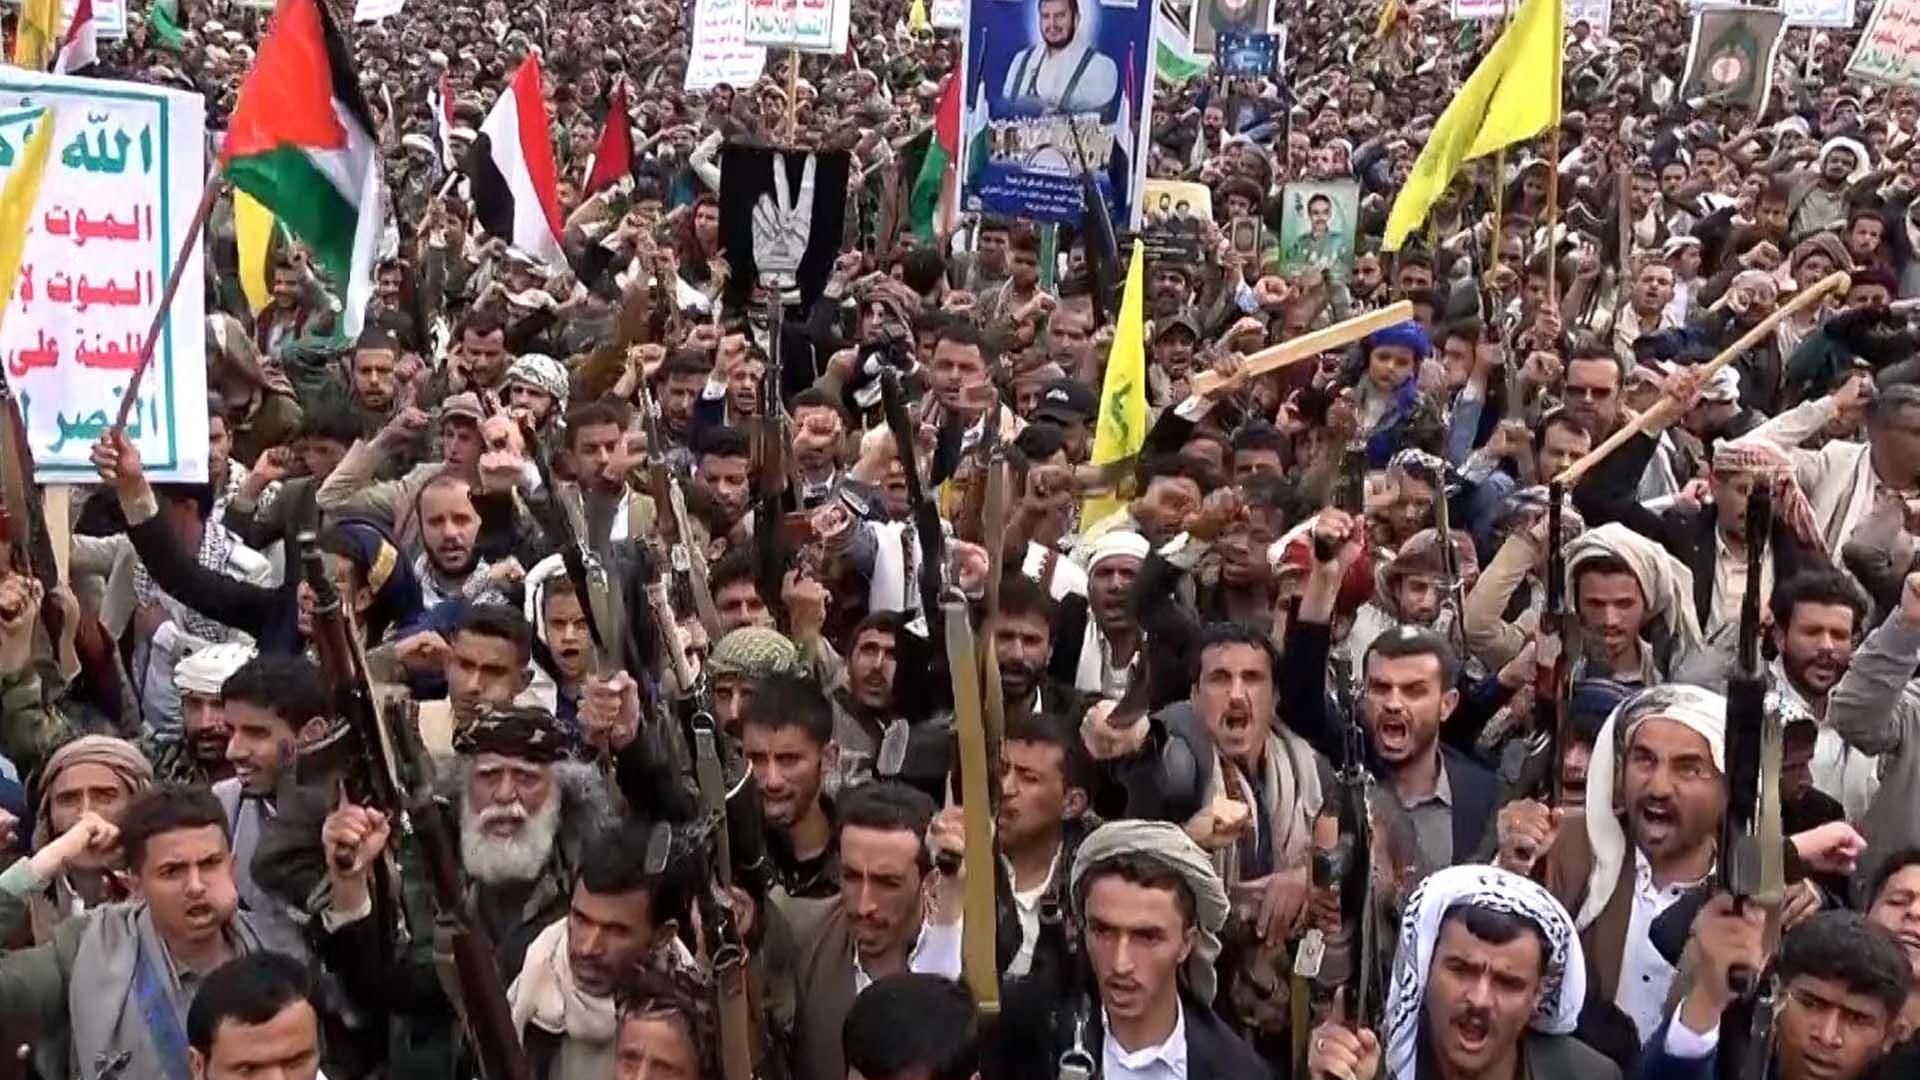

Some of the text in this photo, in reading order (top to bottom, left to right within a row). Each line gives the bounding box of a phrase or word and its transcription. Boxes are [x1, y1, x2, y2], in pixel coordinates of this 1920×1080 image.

[62, 112, 152, 173] الله
[45, 204, 152, 247] الموت
[47, 269, 152, 313] الموت
[9, 329, 59, 377] على
